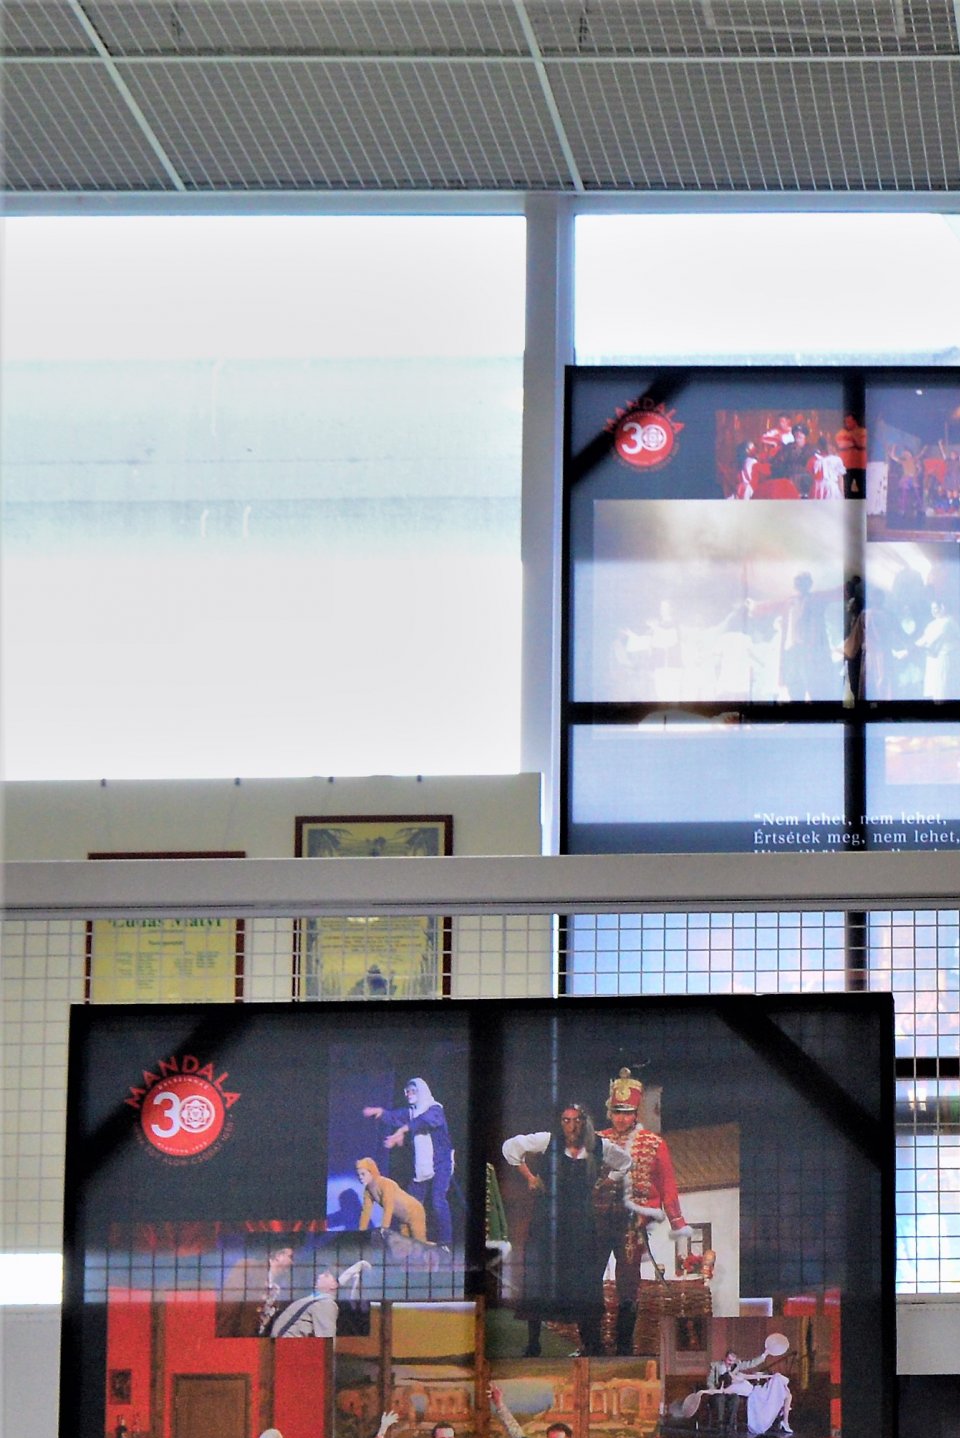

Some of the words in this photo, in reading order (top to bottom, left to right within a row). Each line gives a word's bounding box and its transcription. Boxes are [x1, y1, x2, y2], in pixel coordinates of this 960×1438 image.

[806, 812, 853, 826] lehet,
[860, 814, 894, 825] nem
[901, 811, 948, 826] lehet,
[753, 828, 821, 845] Értsétek
[827, 831, 866, 846] meg,
[873, 831, 907, 843] nem
[914, 829, 960, 844] lehet,
[124, 1054, 241, 1109] MANDALA
